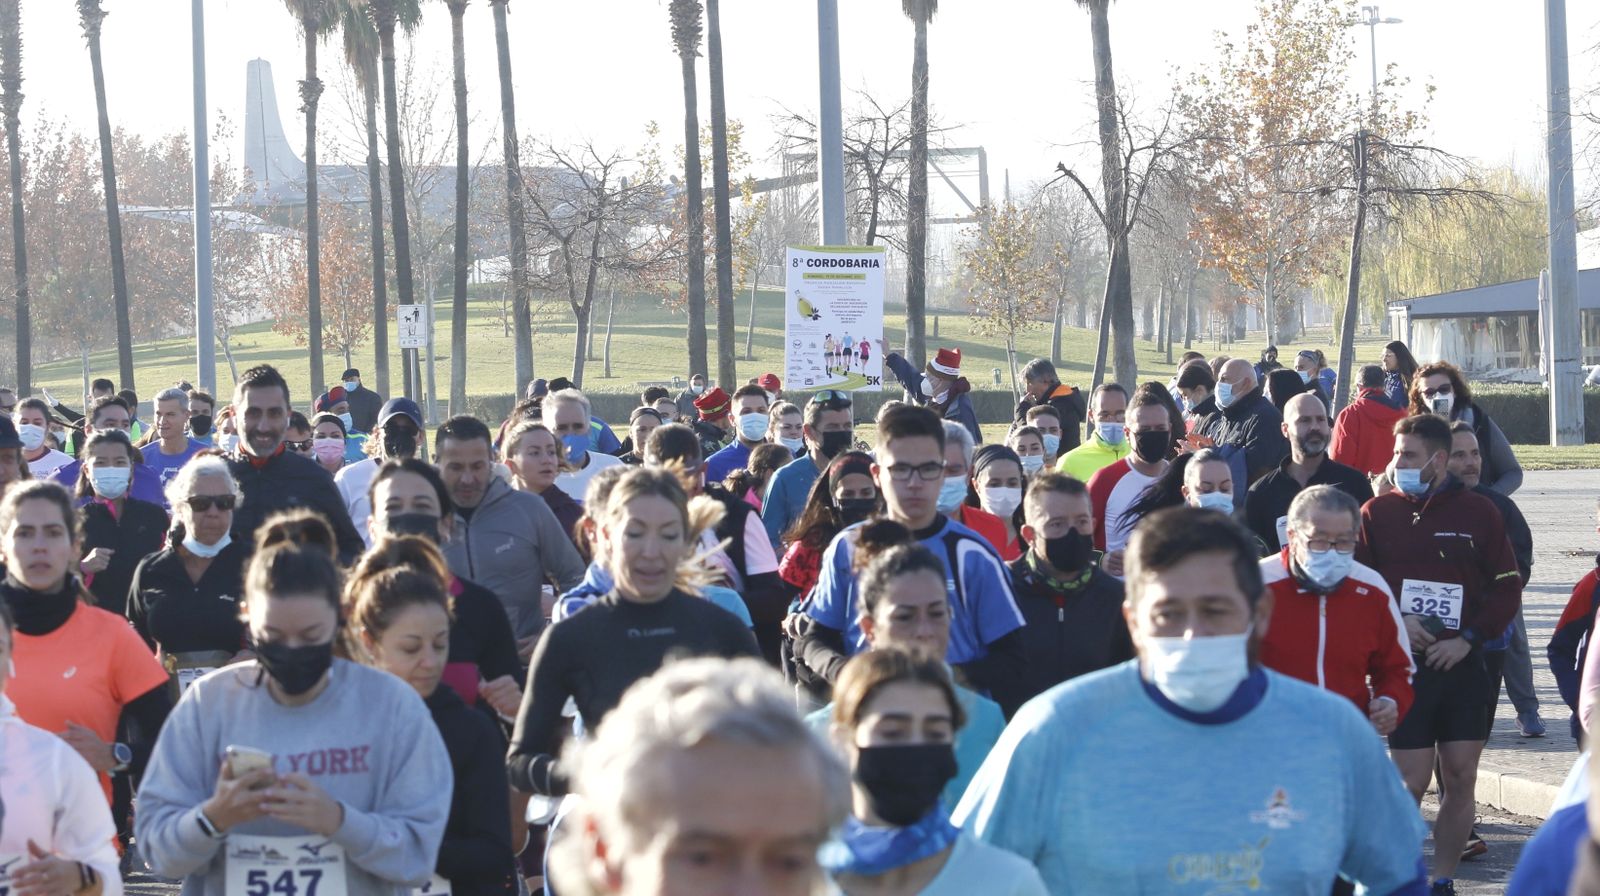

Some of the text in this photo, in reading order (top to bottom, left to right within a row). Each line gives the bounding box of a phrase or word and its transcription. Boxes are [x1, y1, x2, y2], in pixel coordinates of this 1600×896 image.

[806, 258, 880, 268] CORDOBARIA
[866, 375, 881, 386] 5K
[1411, 597, 1451, 616] 325
[287, 744, 371, 777] YORK
[246, 869, 323, 896] 547
